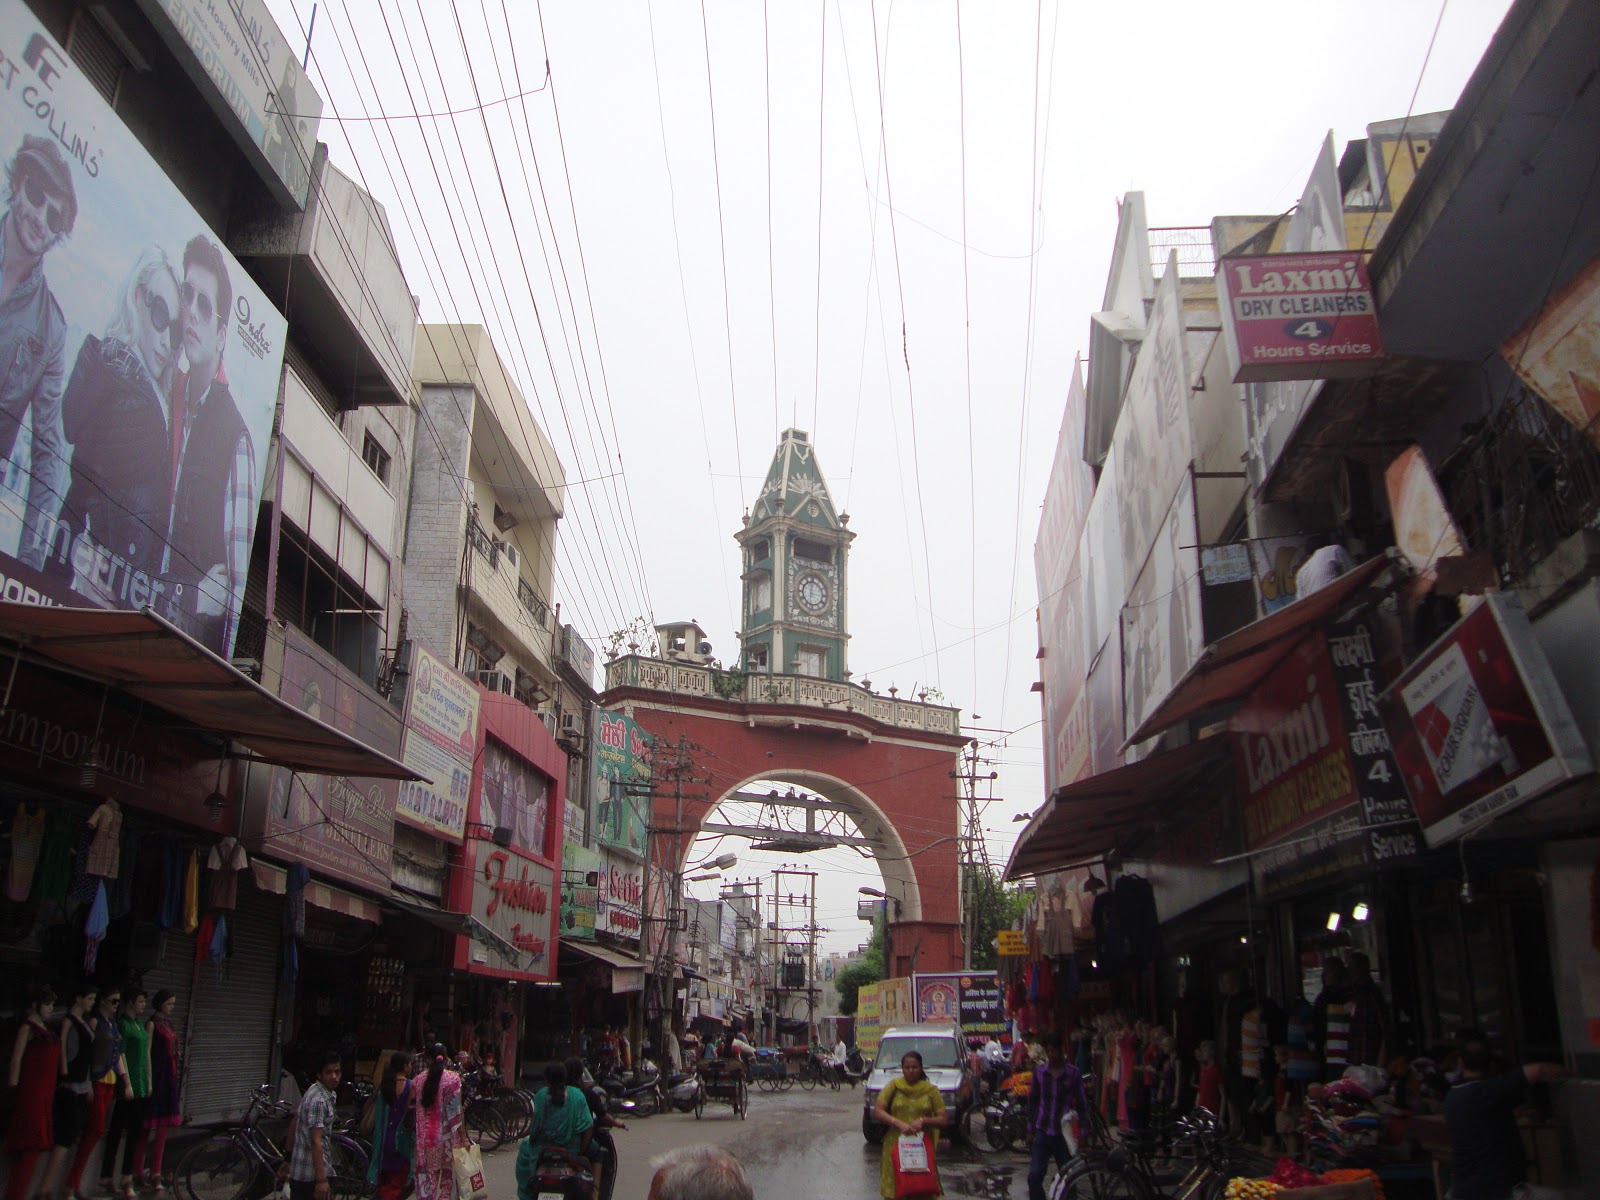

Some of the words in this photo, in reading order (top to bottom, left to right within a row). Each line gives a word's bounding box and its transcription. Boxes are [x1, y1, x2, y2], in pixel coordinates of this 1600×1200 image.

[207, 3, 240, 57] Hosiery
[240, 52, 261, 87] Mills
[167, 0, 252, 127] EMPORIUM
[22, 85, 99, 179] COLLINS
[1235, 261, 1363, 294] Laxmi
[1241, 298, 1273, 317] DRY
[1279, 294, 1368, 315] CLEANERS
[1294, 321, 1322, 337] 4
[1253, 344, 1304, 359] Hours
[1308, 341, 1372, 357] Service
[601, 713, 627, 751] सेठी
[1368, 759, 1392, 783] 4
[325, 816, 391, 863] JEWELLERS
[1371, 831, 1416, 860] Service
[610, 864, 641, 906] Sethi
